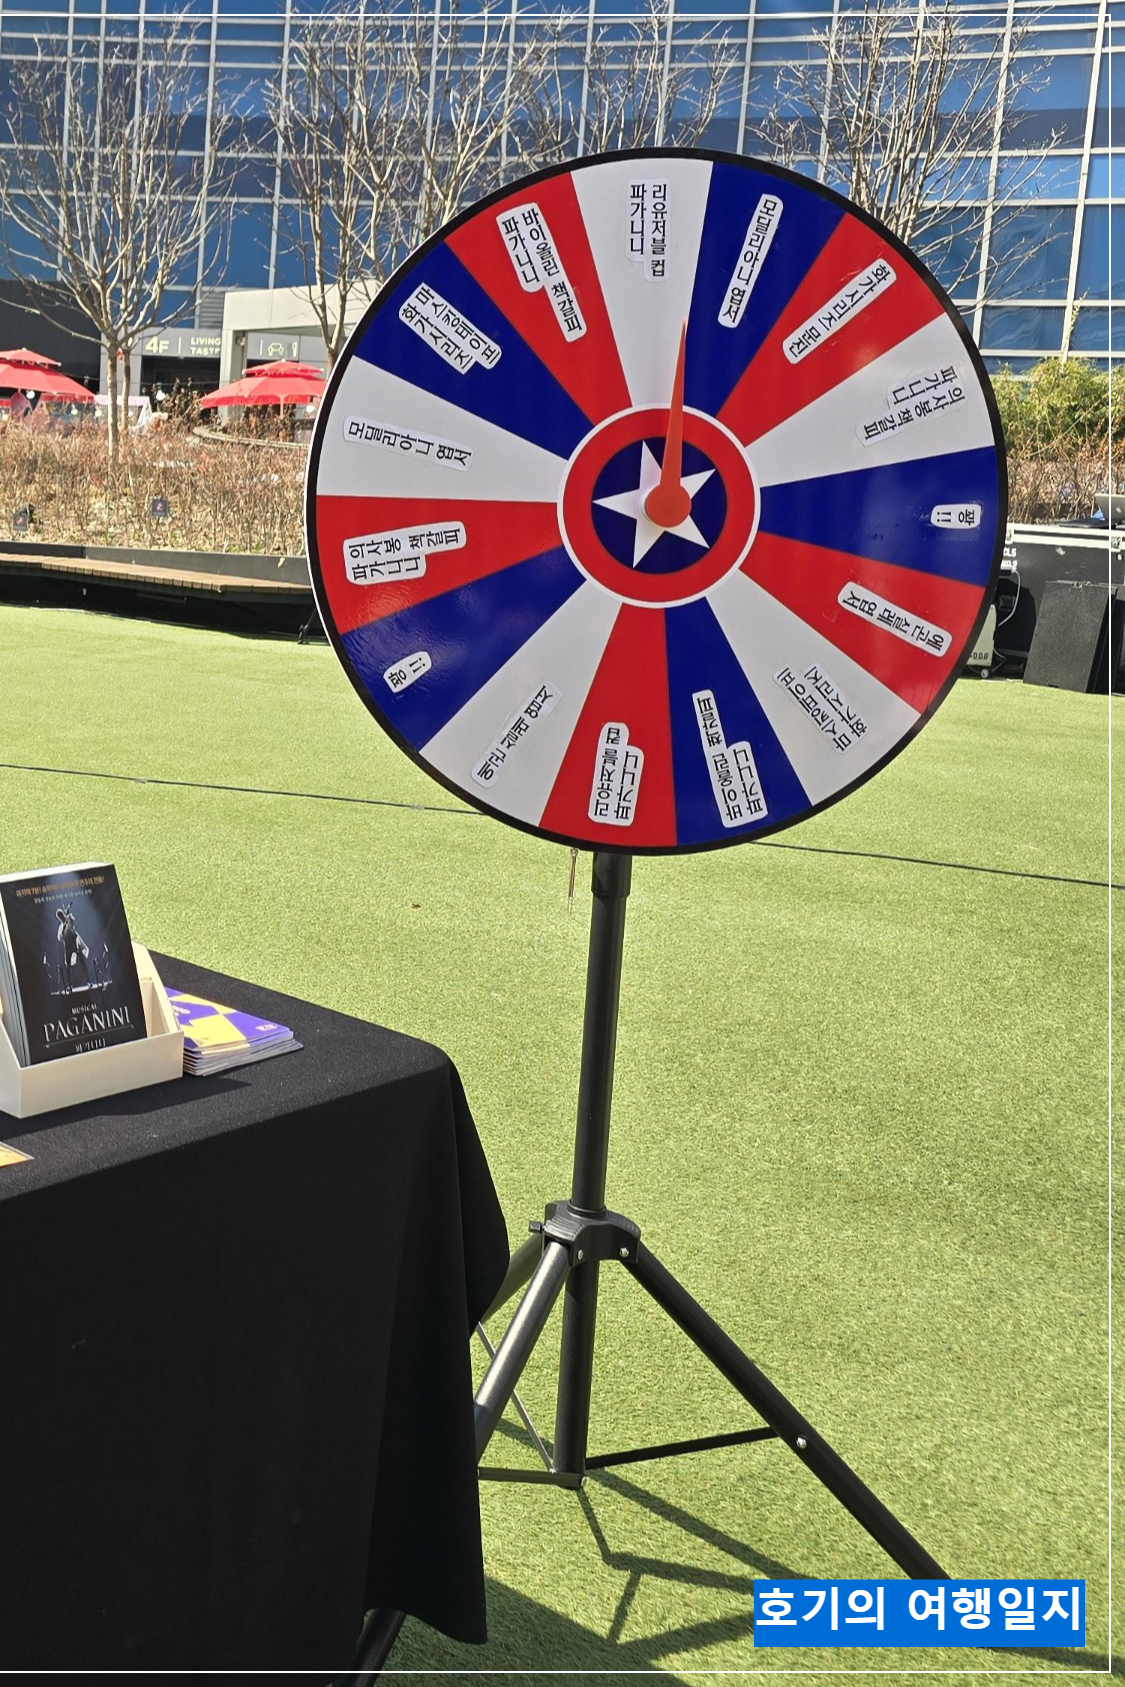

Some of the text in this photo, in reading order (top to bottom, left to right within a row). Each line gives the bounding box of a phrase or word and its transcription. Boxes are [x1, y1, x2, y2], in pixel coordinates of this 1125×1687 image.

[502, 216, 540, 284] 파가니니
[630, 184, 647, 255] 파가니니
[651, 184, 667, 277] 리유저블 컵
[522, 208, 583, 332] 바이올린 책갈피
[722, 199, 778, 323] 모딜리아니 엽서
[190, 337, 221, 346] LIVING
[402, 303, 473, 369] 화가시리즈
[415, 286, 500, 364] 마스킹테이프
[789, 264, 891, 357] 화가시리즈 문진
[145, 336, 170, 354] 4F
[864, 387, 965, 440] 의사봉 책갈피
[892, 366, 957, 405] 파가니니
[349, 421, 472, 466] 모딜리아니 엽서
[349, 528, 461, 558] 의사봉 책갈피
[937, 509, 974, 525] 꽝 !!
[352, 555, 421, 581] 파가니니
[842, 590, 944, 651] 에곤 실레 엽서
[388, 657, 426, 688] 꽝 !!
[804, 666, 867, 737] 화가시리즈
[477, 685, 553, 781] 에곤 실레 엽서
[777, 667, 852, 751] 마스킹테이프
[594, 727, 620, 816] 리유저블 컵
[614, 751, 639, 820] 파가니니
[697, 696, 743, 821] 바이올린 책갈피
[733, 748, 763, 815] 파가니니
[43, 1006, 130, 1042] PAGANINI
[71, 1003, 97, 1015] MUSICAL
